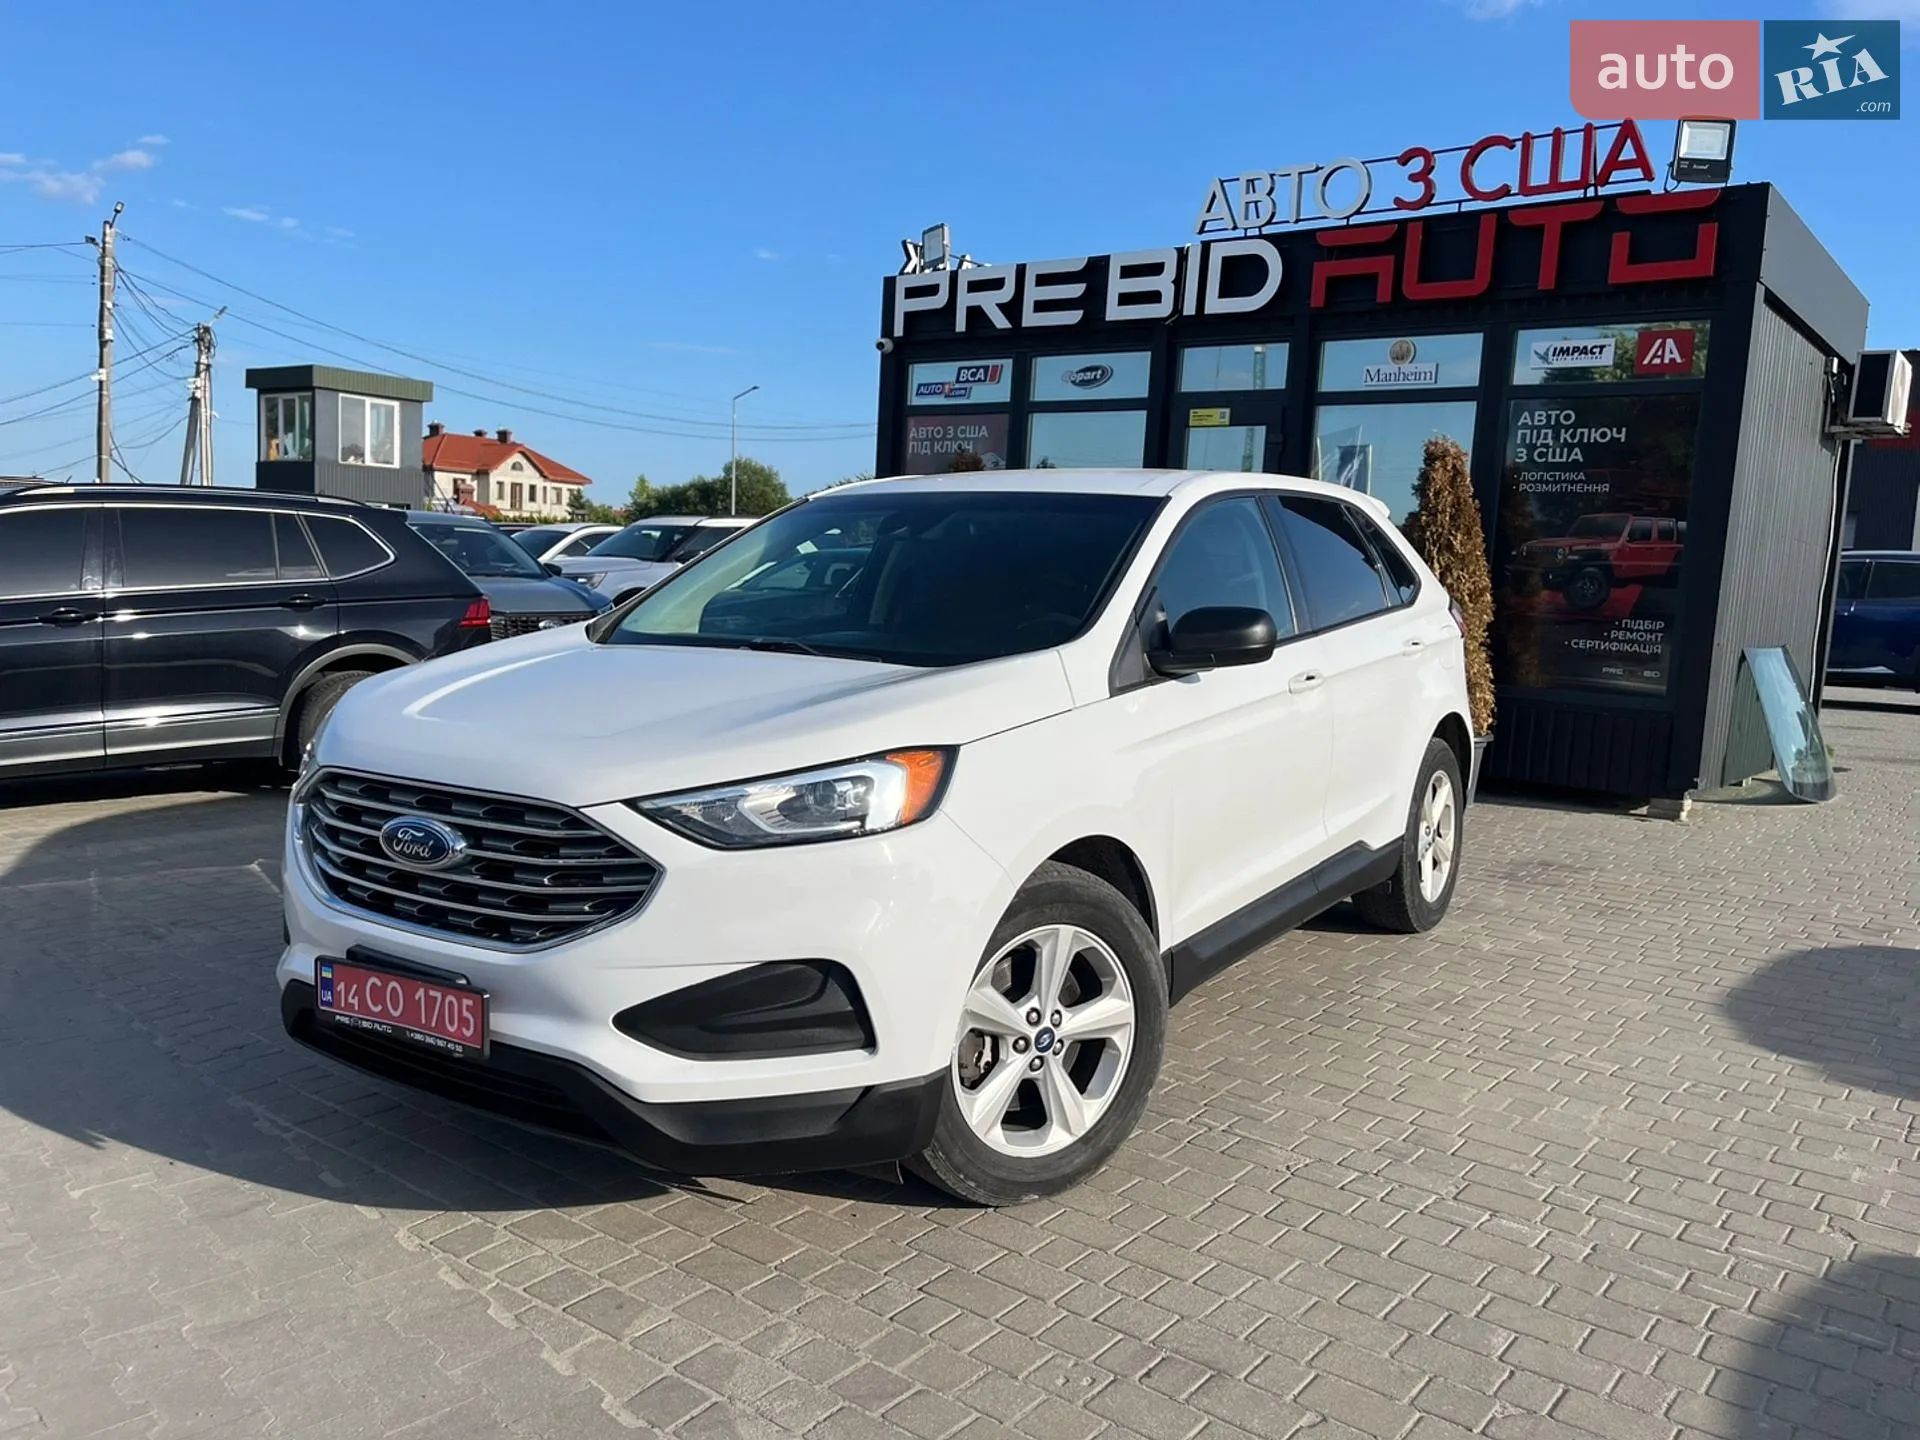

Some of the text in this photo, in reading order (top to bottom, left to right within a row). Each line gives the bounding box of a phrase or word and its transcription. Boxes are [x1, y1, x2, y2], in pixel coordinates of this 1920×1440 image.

[1195, 157, 1373, 235] АВТО
[1461, 119, 1655, 200] США
[1552, 344, 1606, 357] IMPACT
[959, 367, 985, 382] BCA
[1364, 366, 1433, 383] Manheim
[1517, 410, 1576, 426] АВТО
[909, 426, 943, 438] АВТО
[957, 425, 989, 438] США
[1516, 427, 1626, 446] ПІД КЛЮЧ
[908, 441, 931, 455] ПІД
[1533, 447, 1584, 462] США
[1520, 472, 1586, 481] ЛОГІСТИКА
[1519, 483, 1610, 493] РОЗМИТНЕННЯ
[1622, 619, 1665, 630] ПІДБІР
[1610, 630, 1664, 642] РЕМОНТ
[1570, 638, 1662, 654] СЕРТИФІКАЦІЯ
[393, 827, 434, 858] Ford
[321, 988, 332, 1002] UA
[414, 987, 476, 1037] 1705
